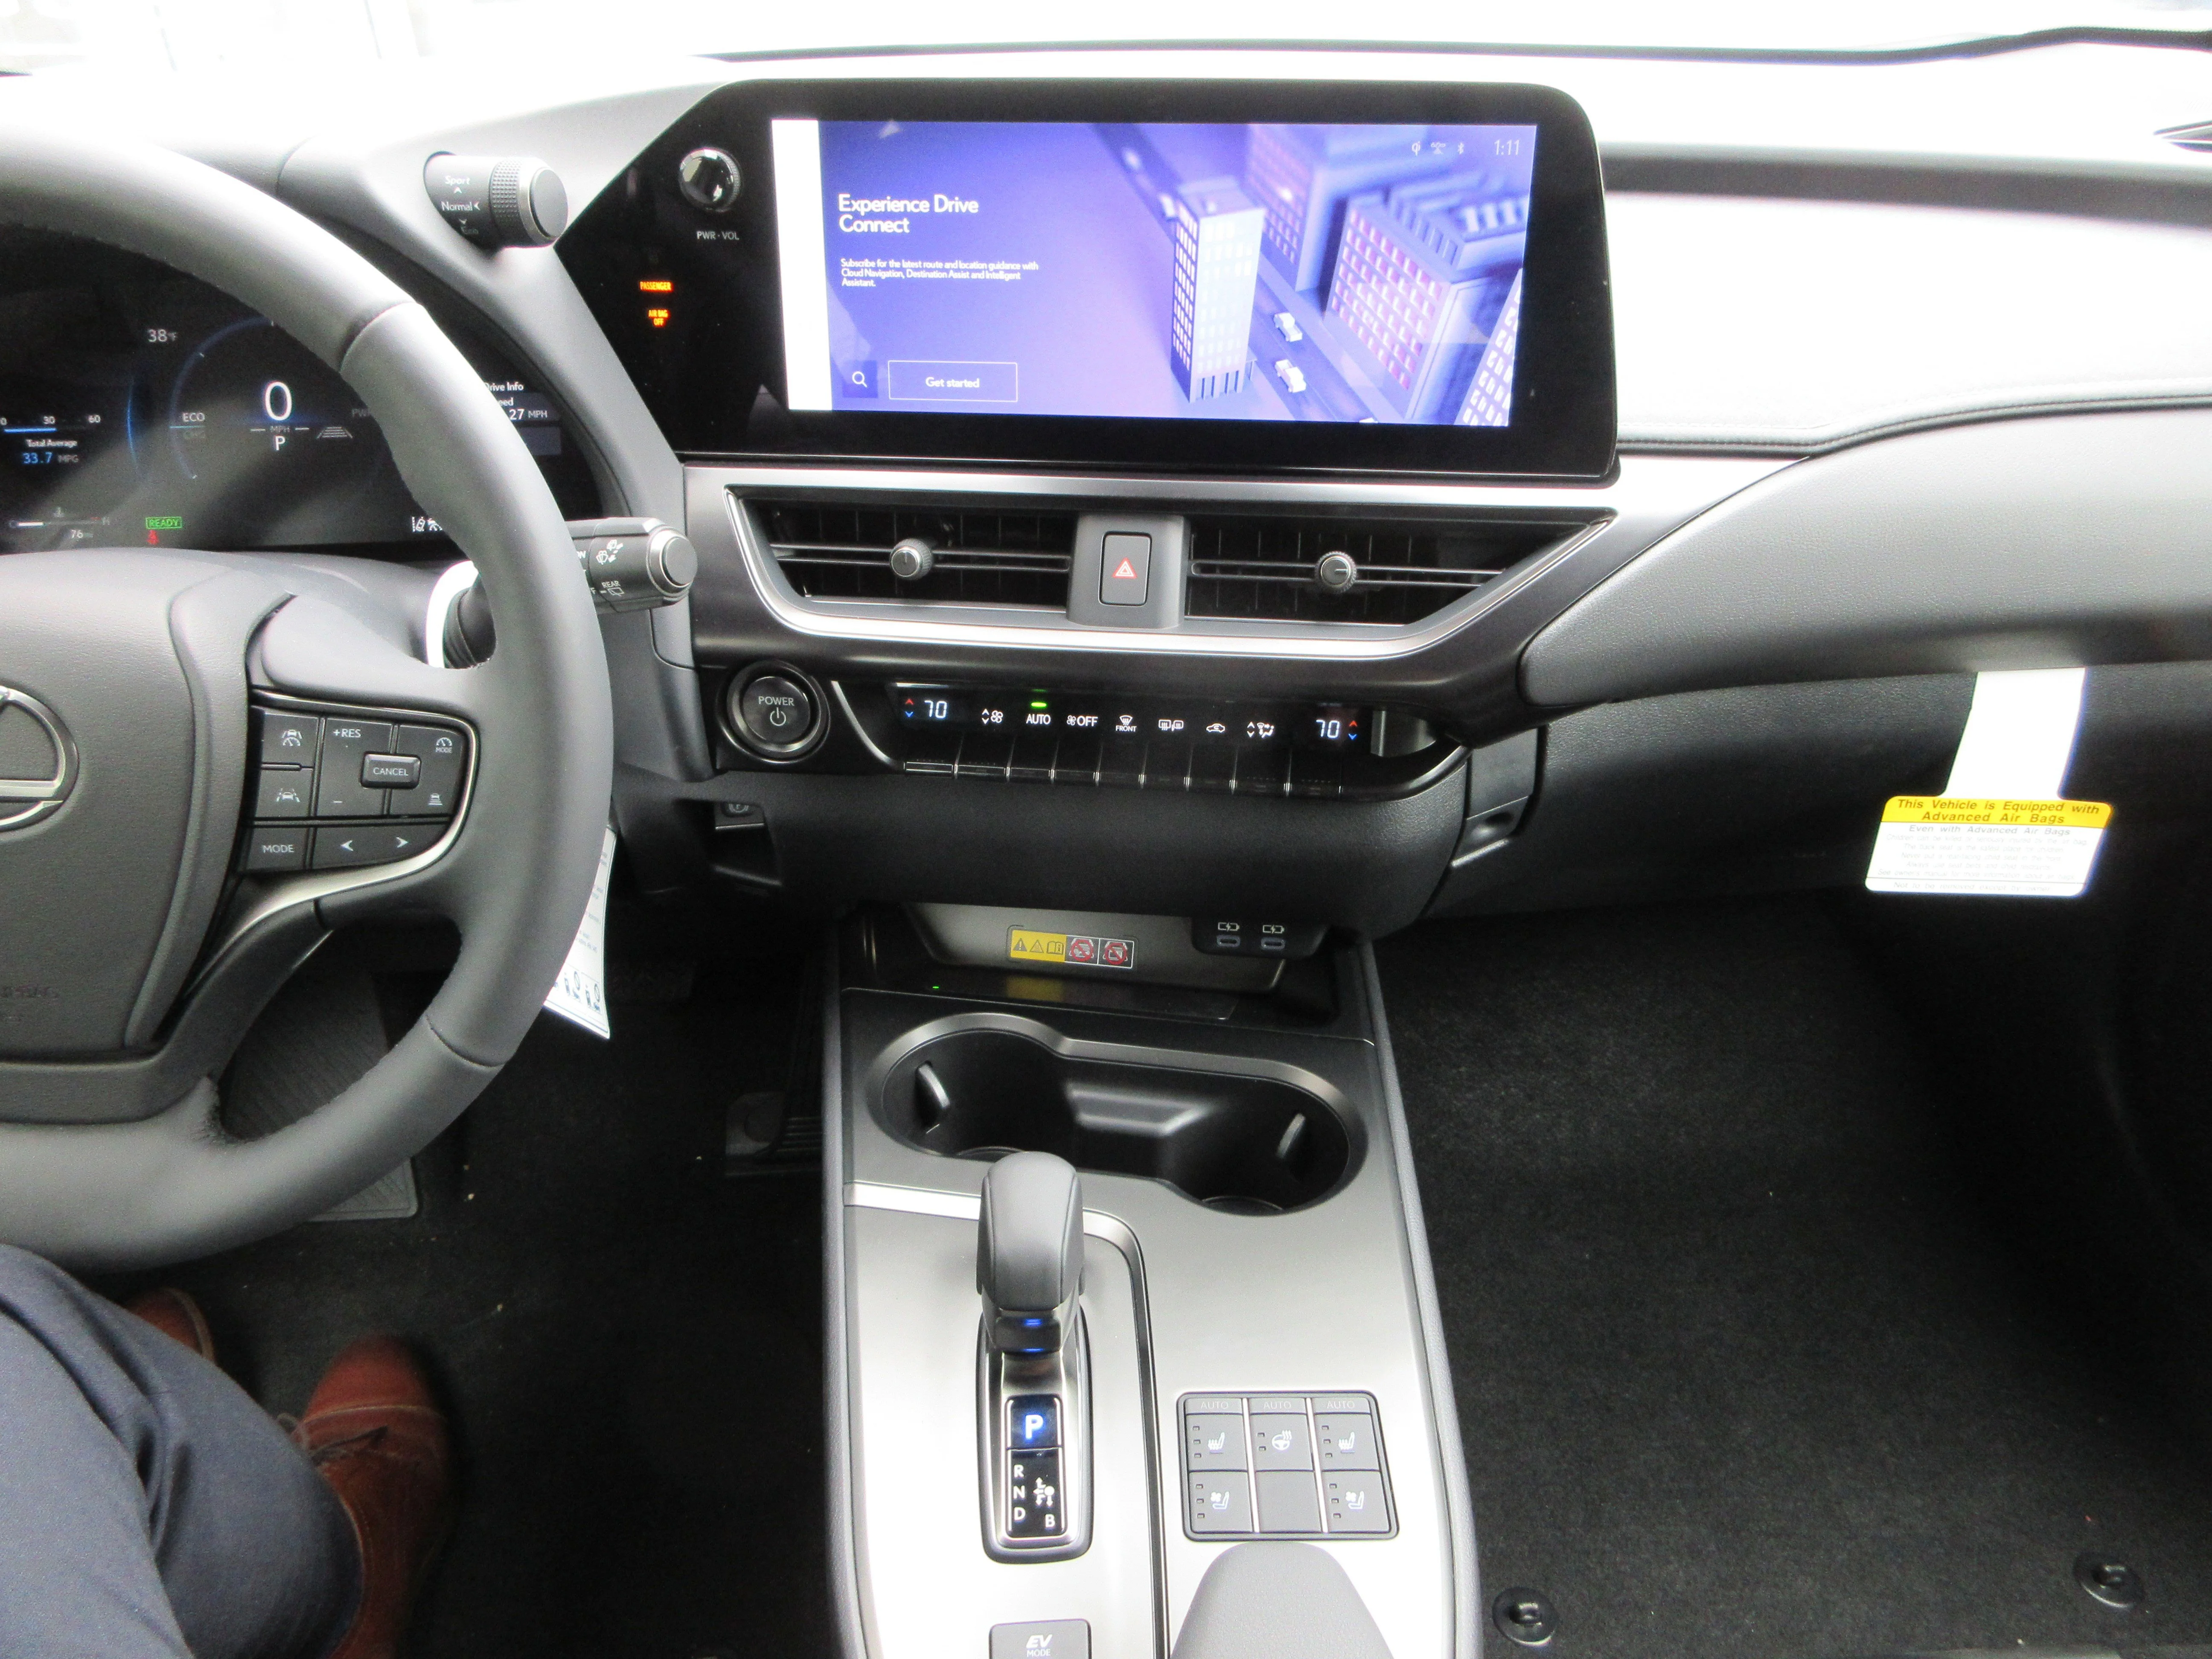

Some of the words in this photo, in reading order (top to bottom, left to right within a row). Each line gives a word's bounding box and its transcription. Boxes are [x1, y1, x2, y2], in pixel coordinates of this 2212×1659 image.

[1494, 139, 1521, 156] 1:11
[445, 175, 471, 186] Sport
[440, 201, 473, 211] Normal
[838, 193, 930, 215] Experience
[934, 194, 979, 213] Drive
[838, 214, 910, 233] Connect
[841, 258, 876, 268] Subscribe
[877, 259, 887, 268] for
[889, 259, 901, 268] the
[902, 260, 922, 269] latest
[923, 261, 943, 269] route
[944, 261, 958, 270] and
[959, 261, 987, 270] location
[989, 262, 1021, 271] guidance
[1022, 262, 1039, 271] with
[841, 268, 864, 277] Cloud
[864, 269, 905, 279] Navigation,
[906, 270, 947, 279] Destination
[949, 270, 970, 279] Assist
[971, 271, 985, 279] and
[986, 271, 1021, 281] Intelligent
[640, 281, 672, 291] PASSENGER
[841, 279, 876, 287] Assistant.
[648, 309, 658, 317] AIR
[658, 309, 669, 318] BAG
[653, 318, 664, 326] OFF
[507, 381, 524, 391] Info
[925, 377, 944, 387] Get
[947, 378, 980, 388] started
[264, 380, 293, 421] 0
[500, 397, 514, 406] eed
[43, 416, 55, 425] 30
[88, 414, 101, 423] 60
[182, 412, 205, 422] ECO
[509, 408, 525, 420] 27
[528, 410, 547, 418] MPH
[270, 425, 290, 433] MPH
[26, 439, 46, 448] Total
[47, 439, 78, 448] Average
[275, 435, 285, 451] P
[23, 451, 52, 464] 33.7
[58, 454, 79, 463] MPG
[149, 518, 179, 527] READY
[70, 529, 83, 539] 76
[602, 580, 621, 588] REAR
[758, 696, 795, 706] POWER
[924, 700, 948, 719] 70
[1026, 713, 1051, 725] AUTO
[1077, 715, 1098, 726] OFF
[1316, 719, 1340, 739] 70
[373, 767, 409, 776] CANCEL
[1898, 799, 1924, 809] This
[1932, 799, 1977, 810] Vehicle
[1984, 800, 1995, 810] is
[2002, 801, 2065, 813] Equipped
[2071, 804, 2100, 814] with
[1921, 811, 1991, 822] Advanced
[2000, 813, 2020, 822] Air
[2029, 813, 2065, 824] Bags
[1909, 824, 1934, 832] Even
[1967, 826, 2018, 834] Advanced
[2044, 828, 2071, 837] Bags
[262, 844, 295, 853] MODE
[1200, 1401, 1229, 1409] AUTO
[1263, 1401, 1292, 1409] AUTO
[1326, 1400, 1355, 1409] AUTO
[1025, 1415, 1044, 1440] P
[1014, 1464, 1024, 1478] R
[1013, 1485, 1025, 1499] N
[1014, 1508, 1026, 1521] D
[1045, 1514, 1056, 1528] B
[1026, 1634, 1053, 1649] EV
[1026, 1648, 1051, 1657] MODE
